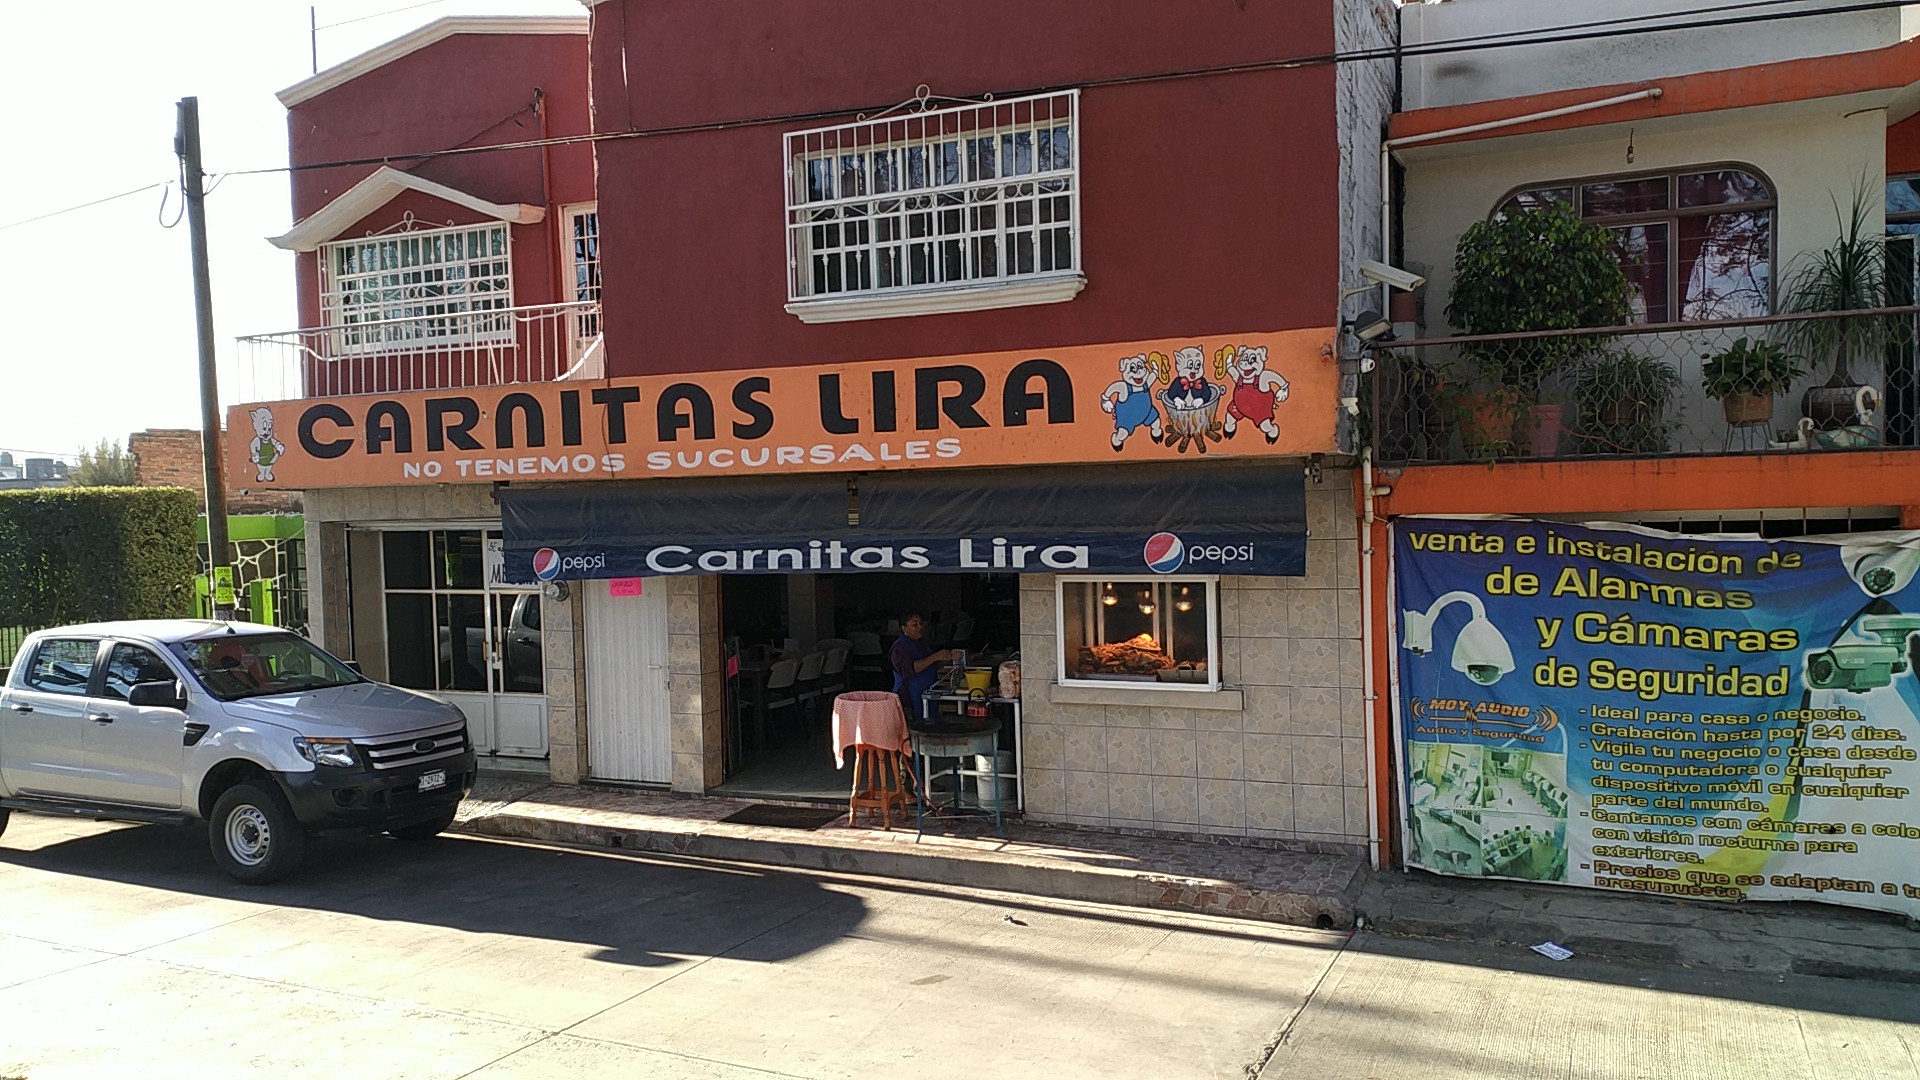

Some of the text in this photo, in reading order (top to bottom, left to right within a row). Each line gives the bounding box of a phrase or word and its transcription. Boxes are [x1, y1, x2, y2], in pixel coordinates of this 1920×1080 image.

[298, 359, 1075, 459] CARNITAS LIRA
[404, 438, 962, 479] NO TENEMOS SUCURSALES
[562, 552, 606, 572] pepsi
[645, 538, 1089, 573] Carnitas Lira
[1189, 541, 1255, 566] pepsi
[1409, 530, 1802, 575] venta e instalación de
[1485, 566, 1754, 610] de Alarmas
[1535, 611, 1799, 652] y Cámaras
[1534, 657, 1791, 700] de Seguridad
[1429, 699, 1530, 717] MOY AUDIO
[1591, 704, 1639, 720] Ideal
[1645, 710, 1693, 724] para
[1700, 714, 1750, 725] casa
[1756, 713, 1768, 722] o
[1774, 707, 1866, 722] negocio.
[1417, 726, 1457, 734] Audio
[1472, 728, 1545, 743] Seguridad
[1591, 722, 1697, 741] Grabación
[1703, 729, 1762, 742] hasta
[1768, 727, 1806, 742] por
[1812, 725, 1846, 740] 24
[1852, 725, 1907, 741] días.
[1591, 739, 1646, 757] Vigila
[1652, 745, 1675, 758] tu
[1680, 745, 1761, 762] negocio
[1767, 746, 1781, 757] o
[1787, 746, 1840, 759] casa
[1846, 745, 1917, 760] desde
[1591, 758, 1892, 782] tu computadora o cualquier
[1591, 776, 1909, 799] dispositivo móvil en cualquier
[1592, 794, 1769, 813] parte del mundo.
[1592, 809, 1697, 827] Contamos
[1702, 816, 1742, 830] con
[1747, 817, 1846, 835] cámaras
[1852, 823, 1866, 835] a
[1592, 827, 1858, 855] con visión nocturna para
[1592, 845, 1705, 864] exteriores.
[1594, 860, 1680, 880] Precios
[1686, 870, 1729, 885] que
[1735, 874, 1765, 886] se
[1770, 874, 1875, 893] adaptan
[1881, 883, 1898, 896] a
[1594, 876, 1747, 898] presupuesto.
